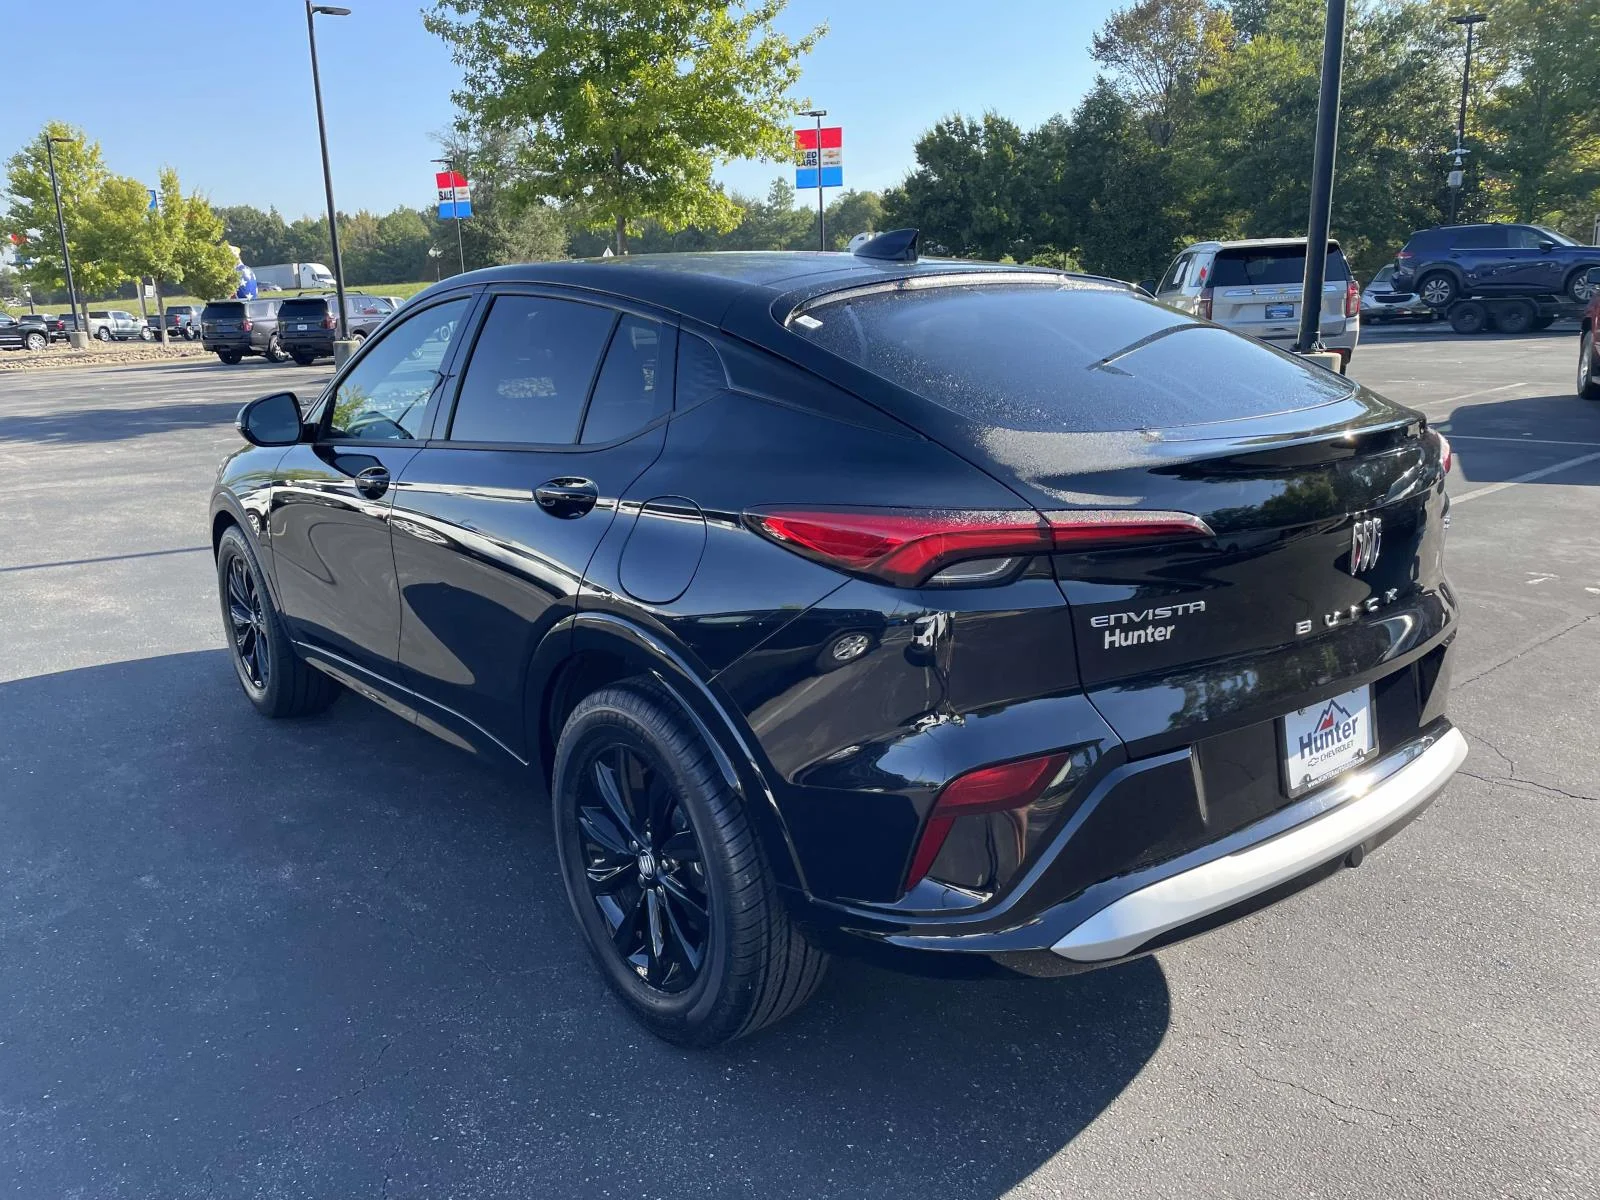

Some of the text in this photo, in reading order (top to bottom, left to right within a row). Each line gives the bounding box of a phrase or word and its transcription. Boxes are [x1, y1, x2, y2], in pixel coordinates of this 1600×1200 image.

[439, 190, 452, 200] SALE
[1090, 600, 1206, 628] ENVISTA
[1295, 588, 1398, 634] BUICK
[1104, 625, 1175, 650] Hunter
[1298, 716, 1359, 760] Hunter
[1320, 739, 1354, 762] CHEVROLET
